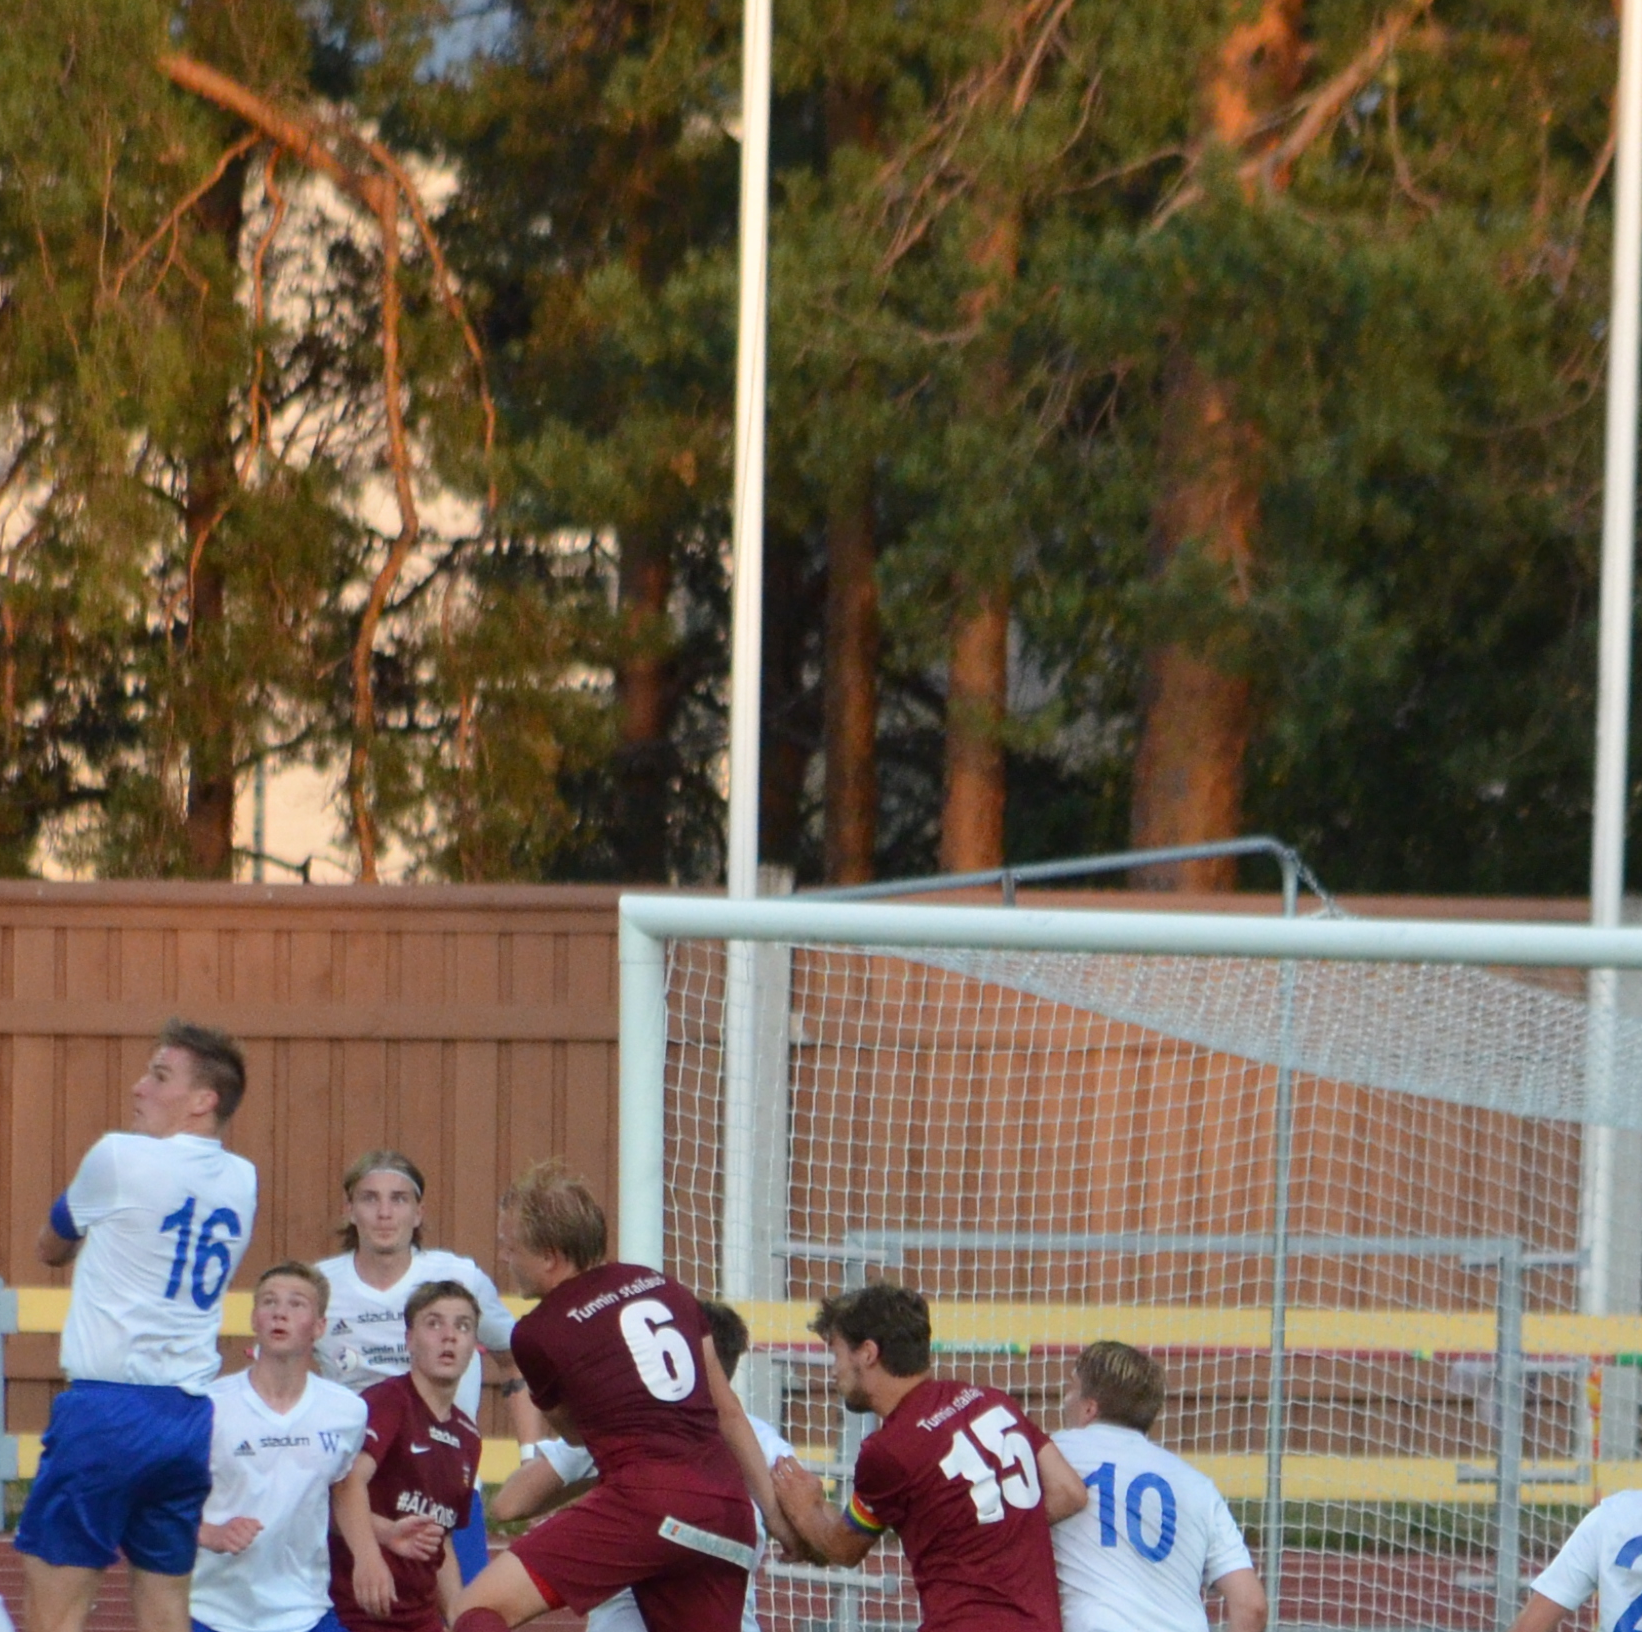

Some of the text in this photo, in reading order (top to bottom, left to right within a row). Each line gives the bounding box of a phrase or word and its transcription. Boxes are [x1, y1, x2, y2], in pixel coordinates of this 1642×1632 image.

[159, 1196, 241, 1311] 16
[566, 1273, 666, 1323] Tunnin stailaus
[619, 1299, 696, 1402] 6
[260, 1431, 340, 1454] stadium W
[916, 1404, 957, 1432] Tunnin
[938, 1405, 1042, 1526] 15
[1082, 1462, 1176, 1563] 10
